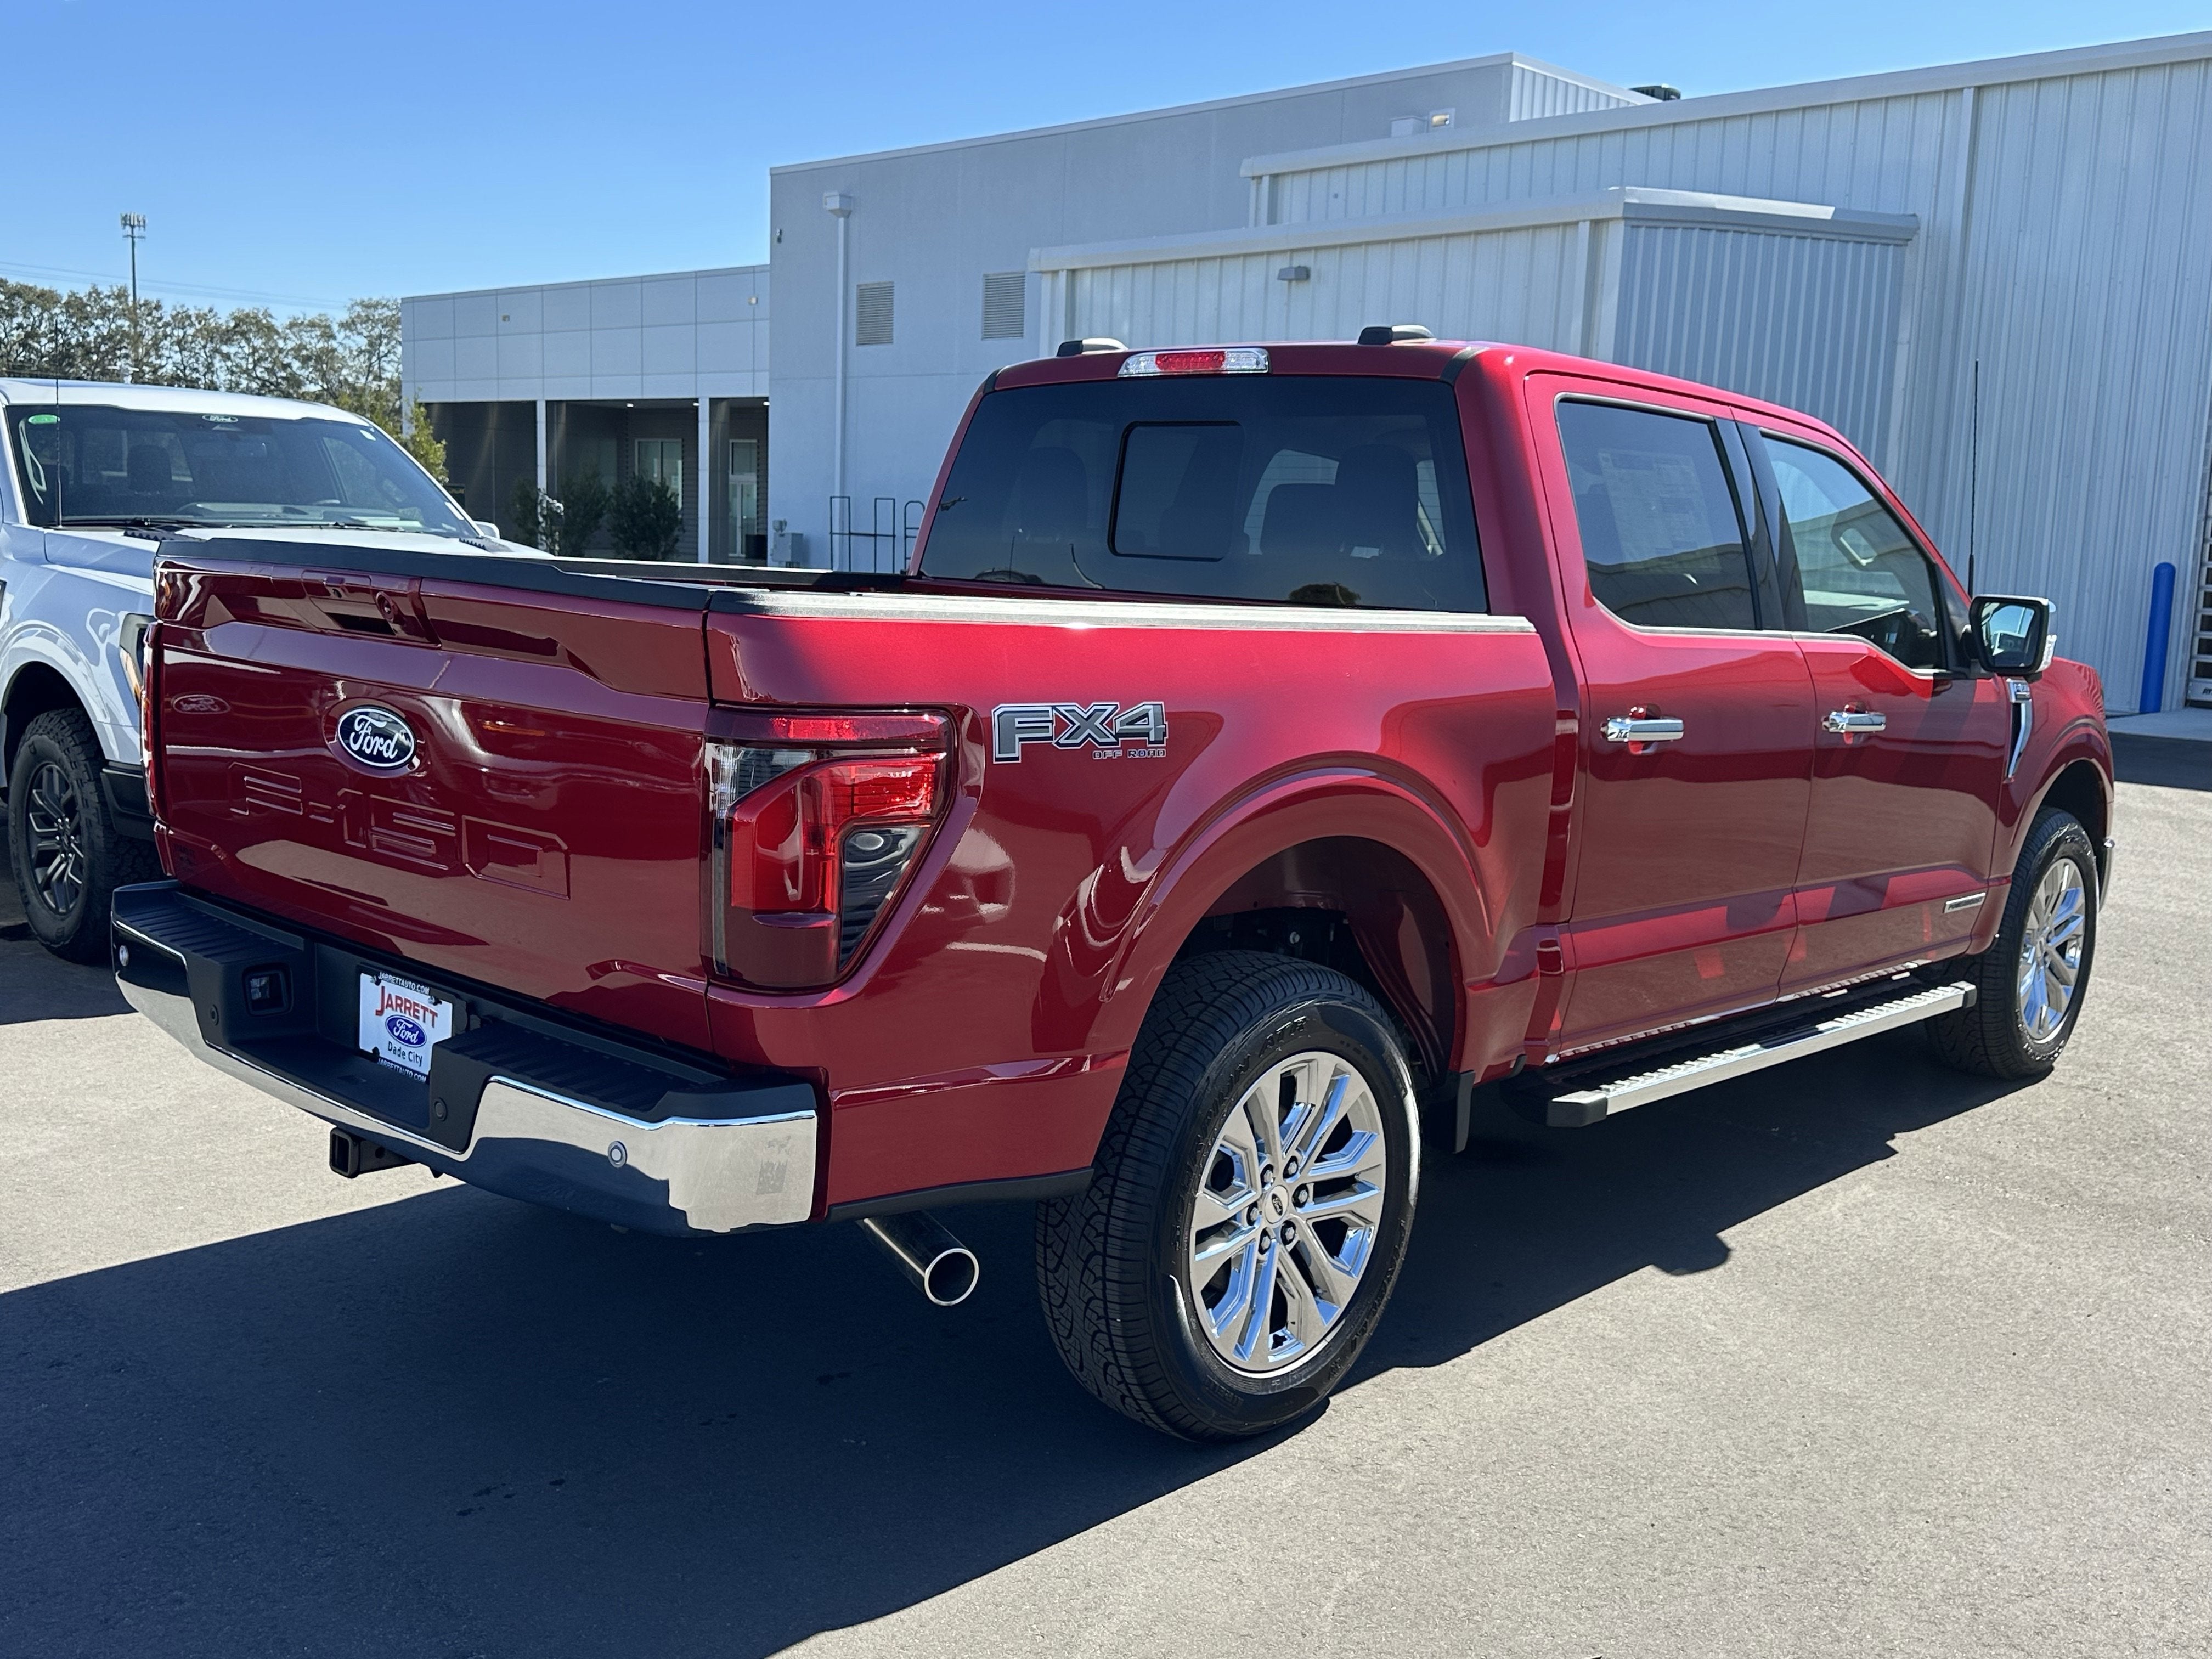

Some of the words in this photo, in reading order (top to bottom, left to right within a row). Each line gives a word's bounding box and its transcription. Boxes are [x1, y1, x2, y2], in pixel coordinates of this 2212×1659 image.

[349, 715, 398, 759] Ford
[991, 701, 1169, 764] FX4
[1092, 750, 1122, 760] OFF
[1127, 748, 1166, 758] ROAD
[228, 761, 571, 900] F-150
[378, 971, 430, 995] JARRETTAUTO.COM
[375, 985, 438, 1029] JARRETT
[393, 1019, 419, 1043] Ford
[1259, 1015, 1307, 1058] ATR
[387, 1041, 407, 1060] Dade
[408, 1050, 423, 1068] City
[1272, 1197, 1283, 1214] Ford
